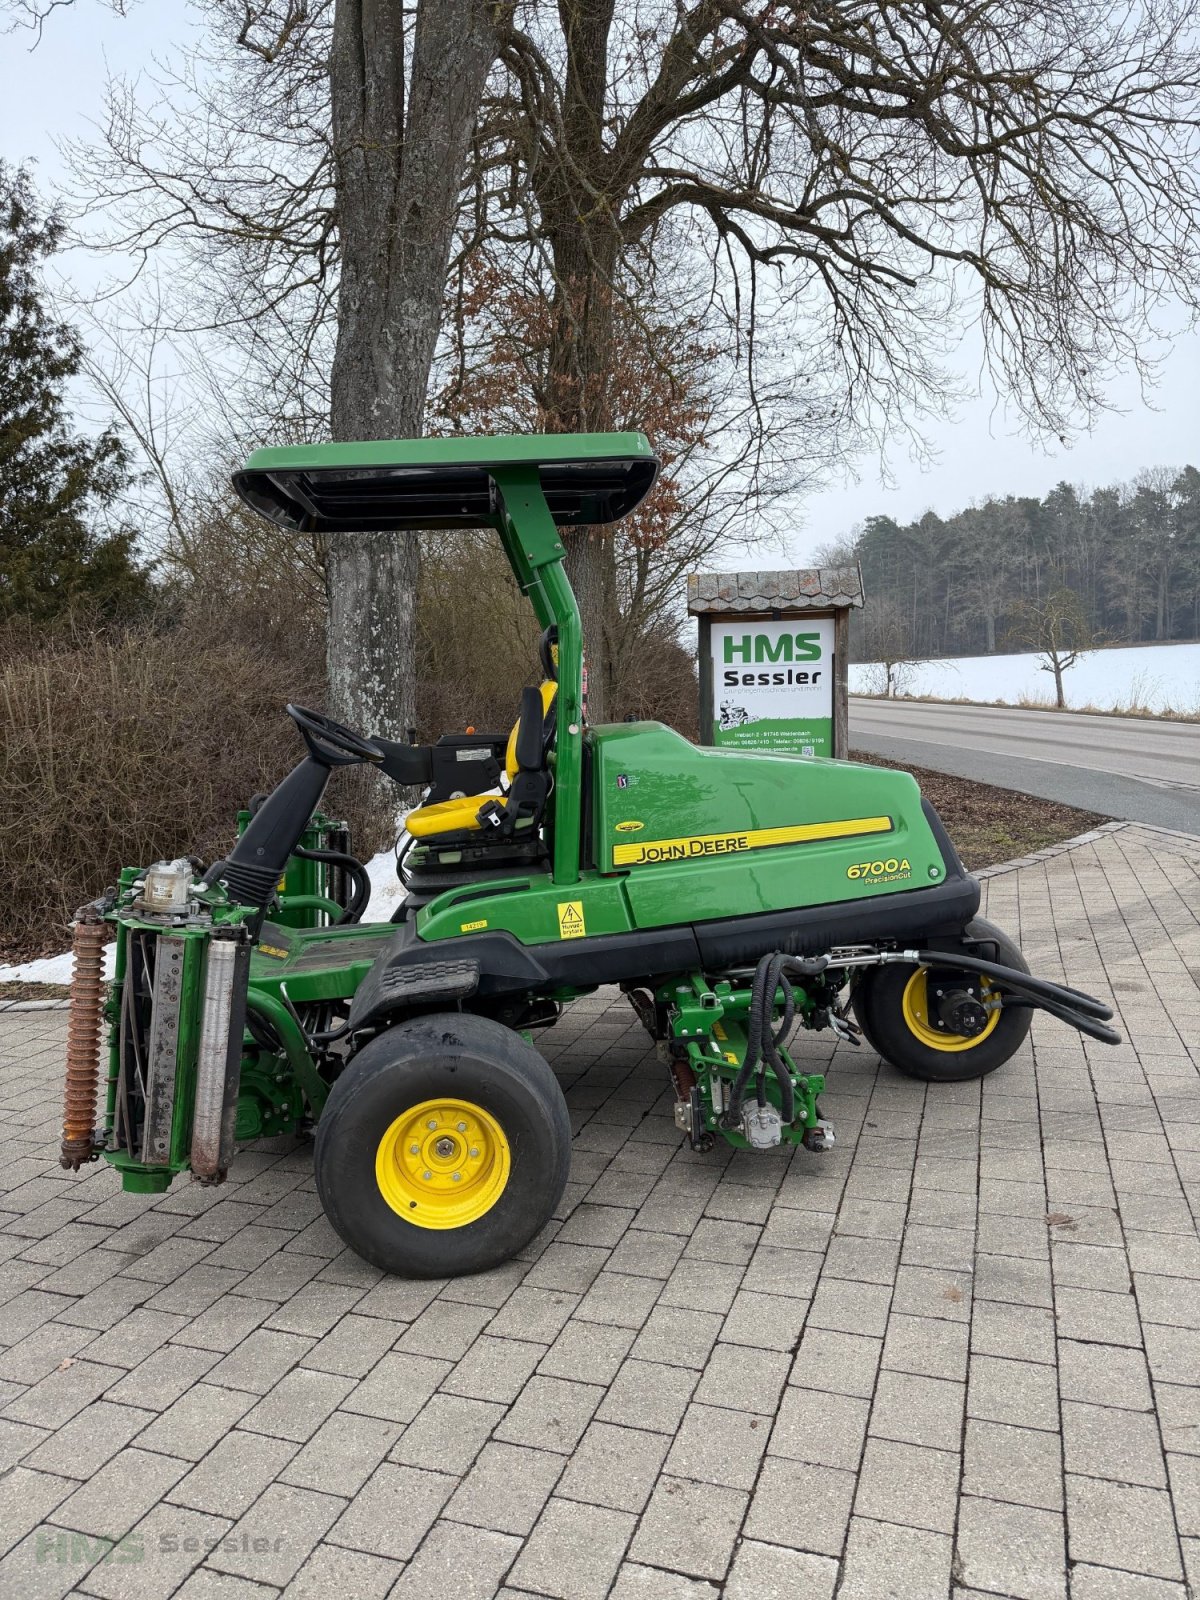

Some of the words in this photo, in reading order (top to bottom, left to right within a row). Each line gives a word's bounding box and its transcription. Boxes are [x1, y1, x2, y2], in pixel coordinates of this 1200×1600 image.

[723, 632, 822, 664] HMS
[723, 668, 822, 687] Sessler
[636, 844, 686, 863] JOHN
[689, 836, 749, 856] DEERE
[847, 858, 911, 879] 6700A
[864, 871, 912, 885] PrecisionCut
